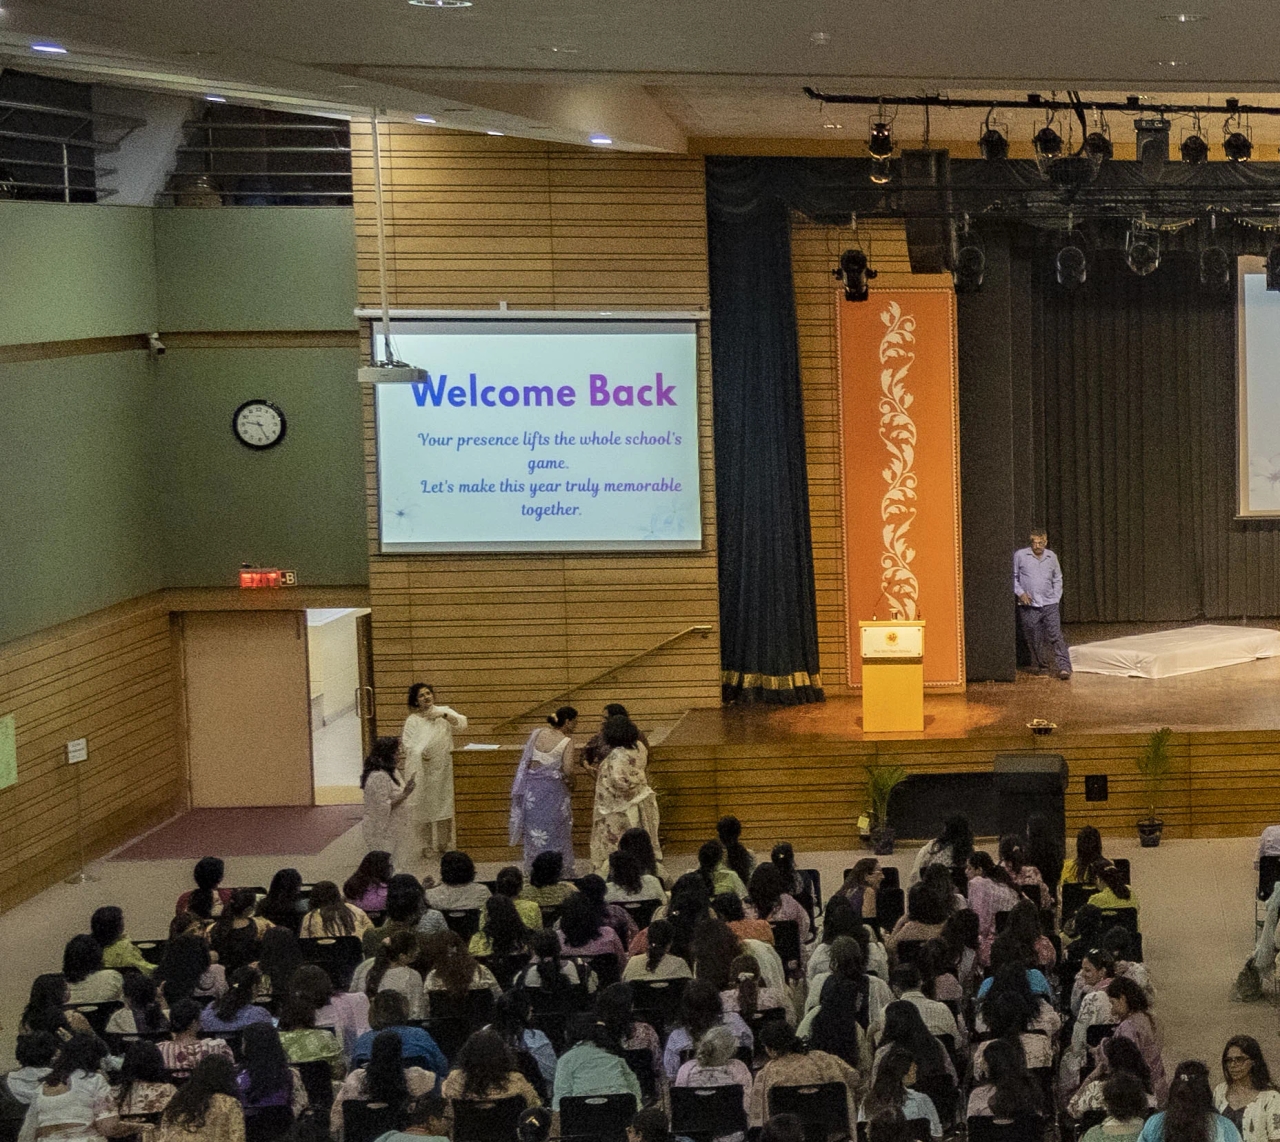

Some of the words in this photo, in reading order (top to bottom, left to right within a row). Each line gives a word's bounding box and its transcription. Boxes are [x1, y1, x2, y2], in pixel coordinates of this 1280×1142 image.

[410, 372, 576, 407] Welcome
[589, 372, 677, 406] Back
[417, 433, 453, 446] Your
[456, 436, 519, 451] presence
[523, 431, 550, 451] lifts
[555, 431, 575, 445] the
[580, 431, 621, 445] whole
[626, 431, 682, 445] school's
[527, 459, 568, 475] game.
[420, 480, 454, 493] Let's
[458, 479, 495, 493] make
[499, 479, 525, 492] this
[529, 482, 561, 498] year
[566, 478, 600, 498] truly
[604, 478, 682, 492] memorable
[522, 502, 581, 521] together.
[241, 573, 277, 588] EXIT
